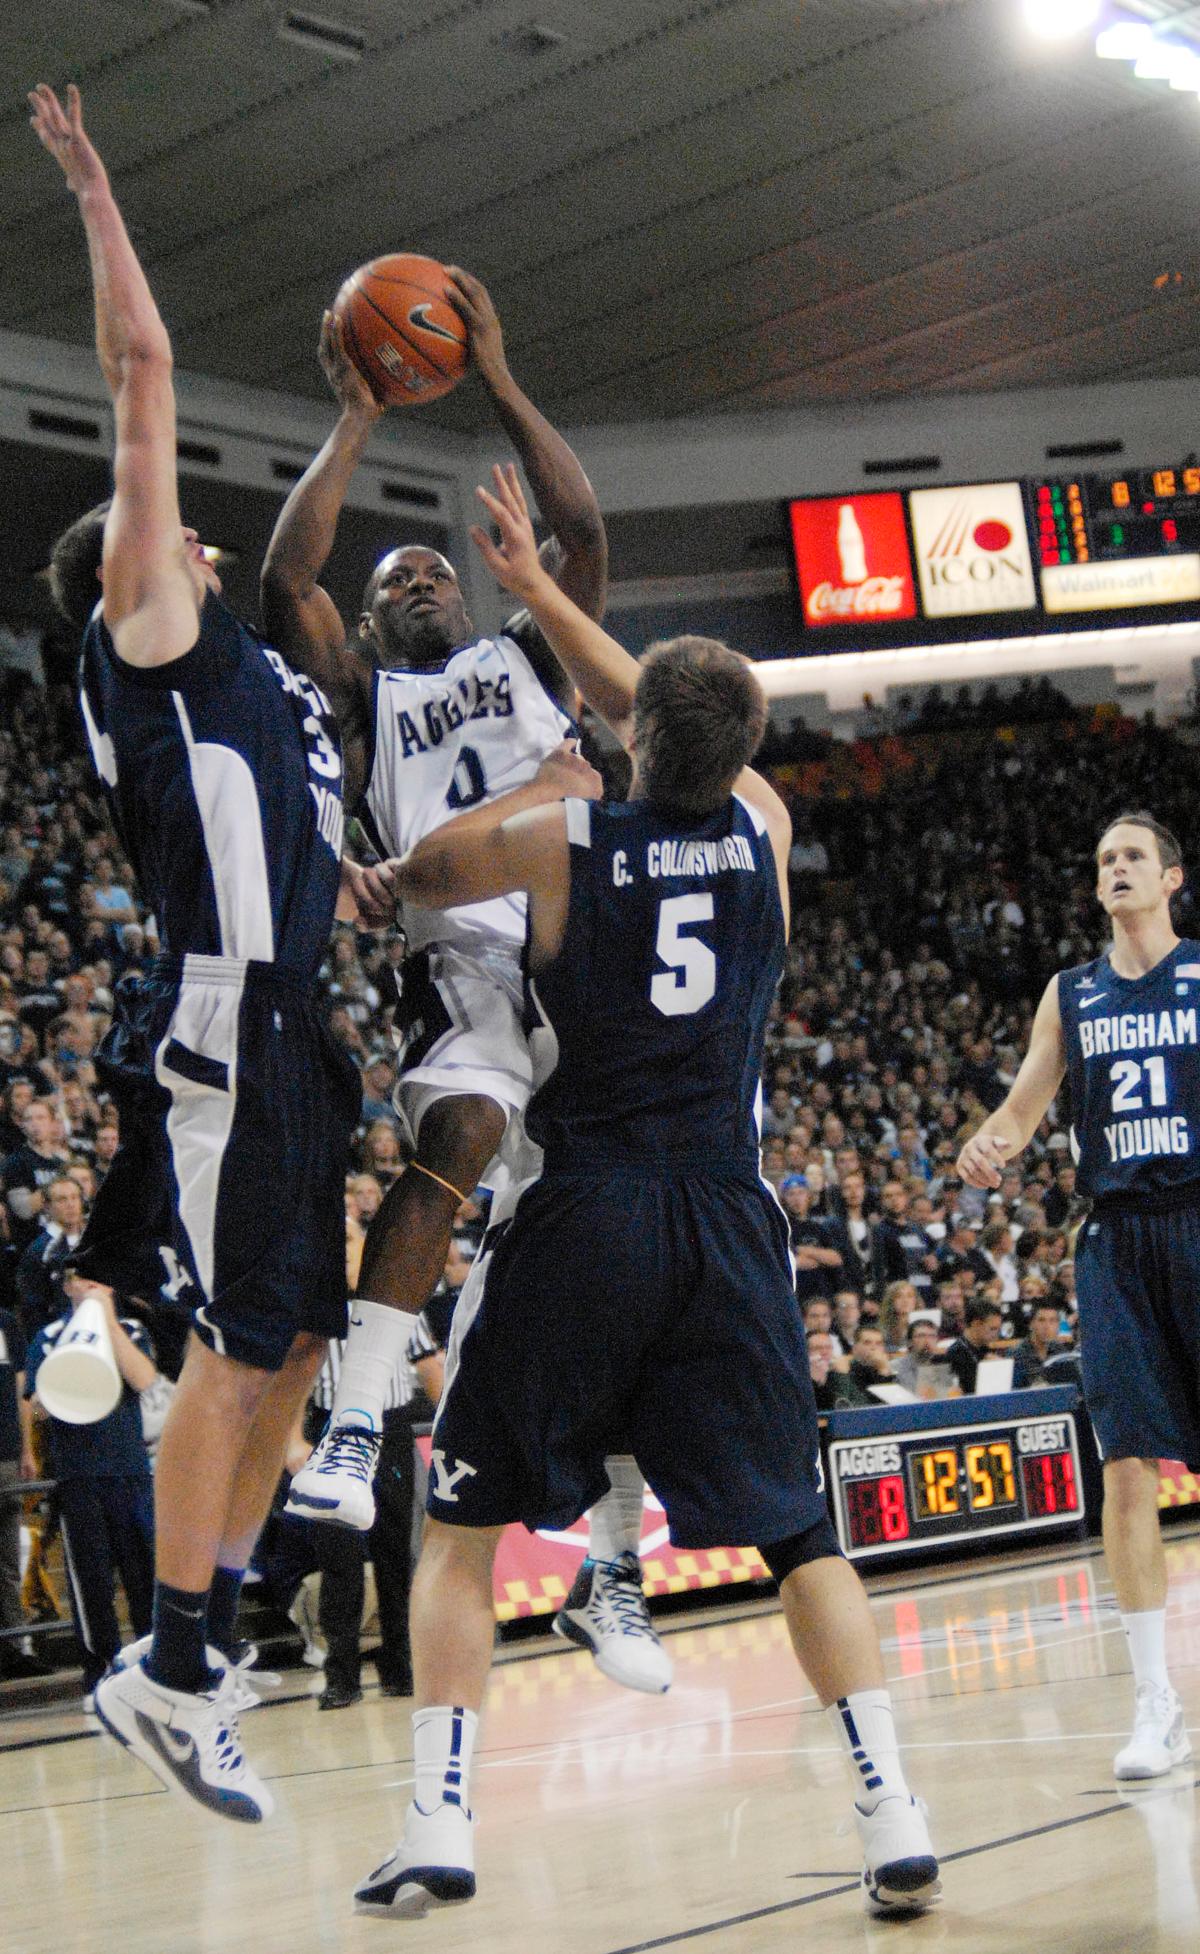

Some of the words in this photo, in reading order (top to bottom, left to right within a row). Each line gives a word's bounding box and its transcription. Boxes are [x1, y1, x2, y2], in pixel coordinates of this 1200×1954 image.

[928, 556, 1025, 587] ICON
[1058, 567, 1155, 593] Walmart
[808, 575, 905, 619] Coca-Cola
[650, 891, 717, 1017] 5
[1078, 1007, 1198, 1059] BRIGHAM
[1109, 1055, 1168, 1113] 21
[1103, 1115, 1190, 1163] YOUNG
[838, 1443, 901, 1477] AGGIES
[1015, 1422, 1067, 1453] GUEST
[431, 1449, 478, 1502] Y
[1041, 1451, 1079, 1513] 11
